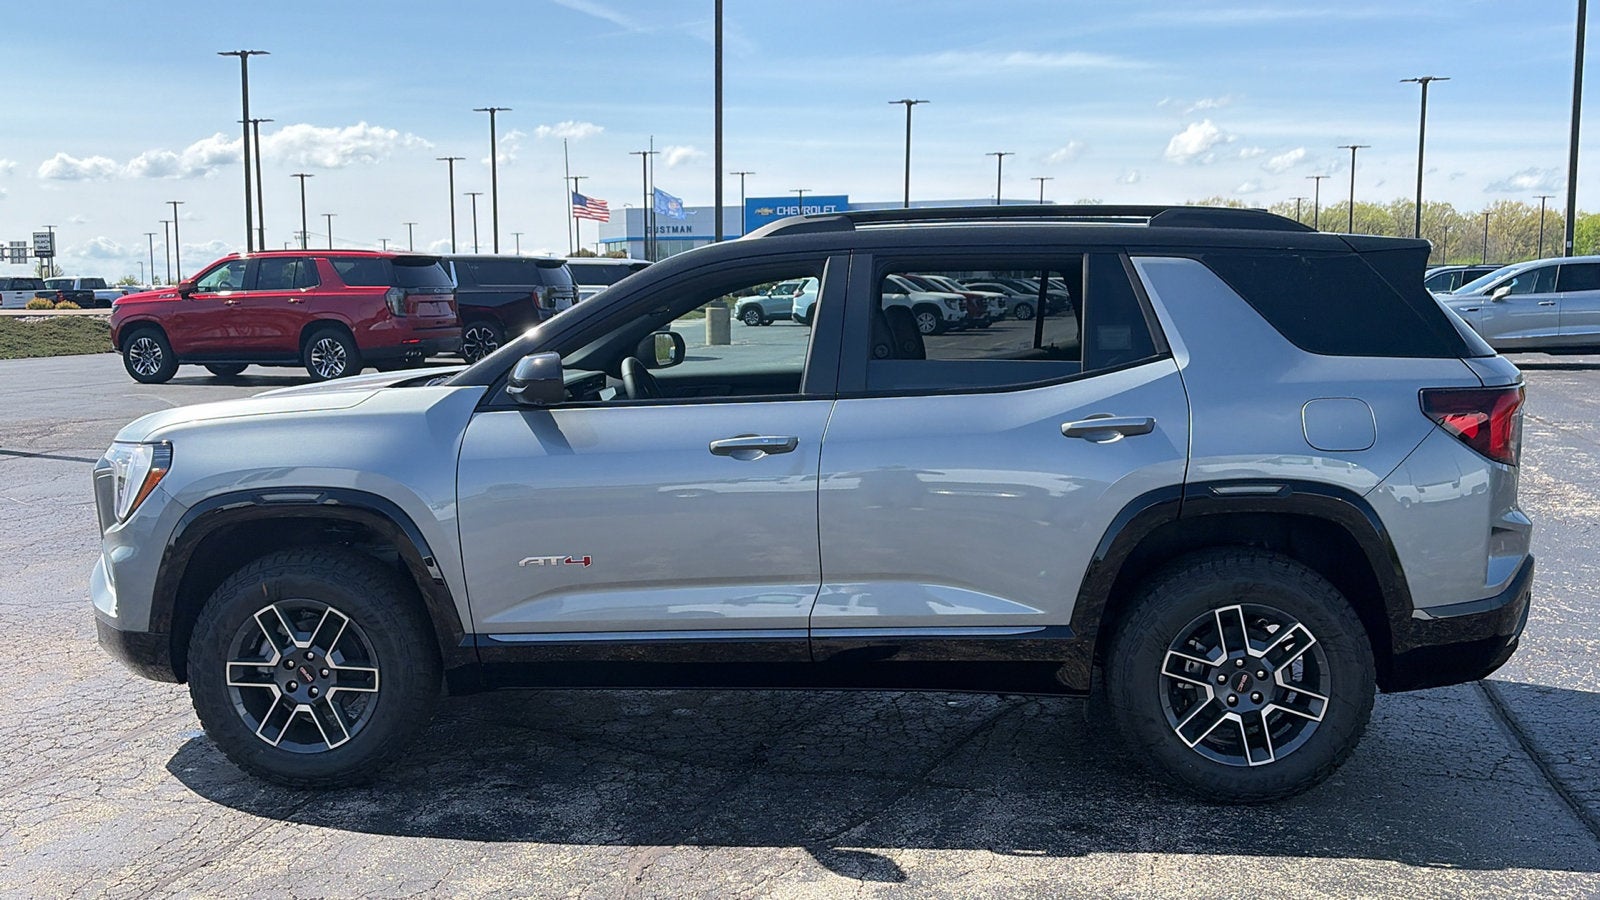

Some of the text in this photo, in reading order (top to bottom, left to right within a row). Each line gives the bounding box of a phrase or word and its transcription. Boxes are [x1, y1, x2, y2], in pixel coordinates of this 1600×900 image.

[777, 205, 836, 216] CHEVROLET
[518, 555, 592, 568] AT4
[1237, 674, 1248, 692] GMC
